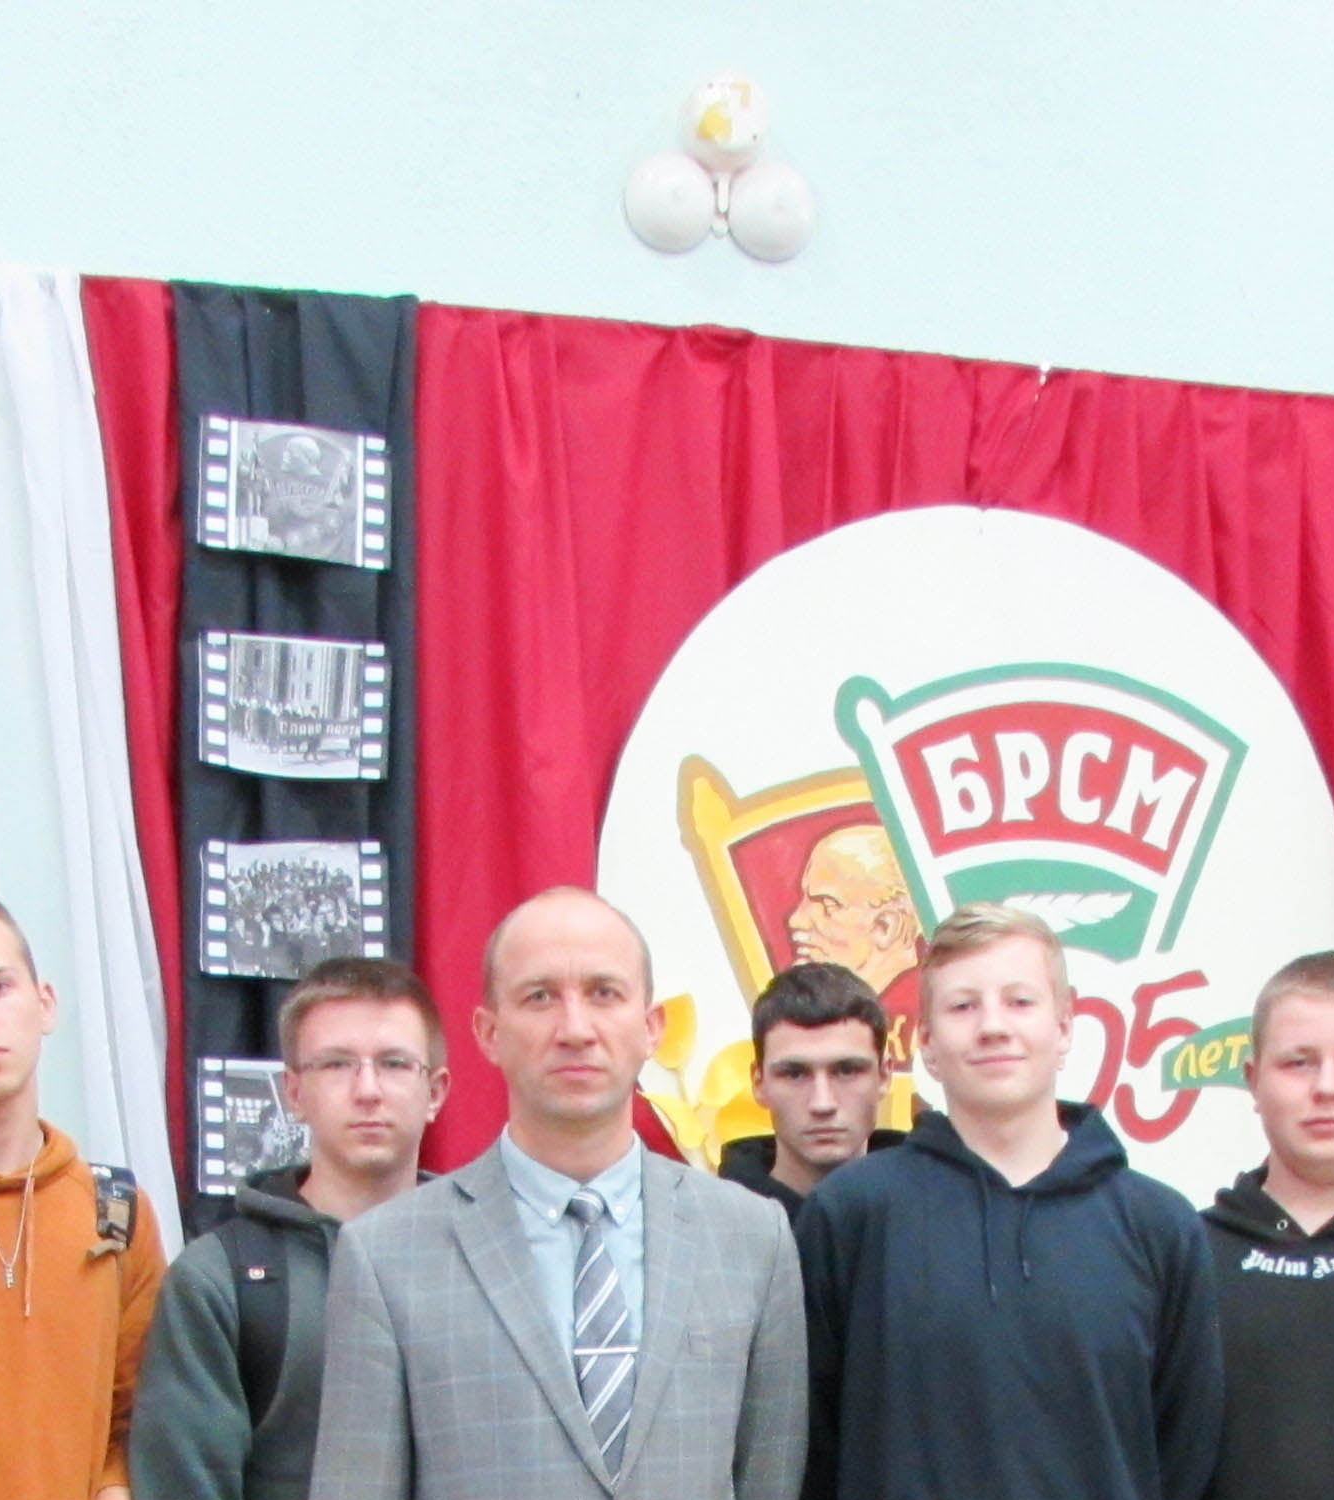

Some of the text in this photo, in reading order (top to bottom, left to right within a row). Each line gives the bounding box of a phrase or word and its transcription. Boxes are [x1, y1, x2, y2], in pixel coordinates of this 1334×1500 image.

[921, 731, 1197, 851] БРСМ
[1173, 1034, 1251, 1083] лет
[1240, 1249, 1307, 1276] Palm
